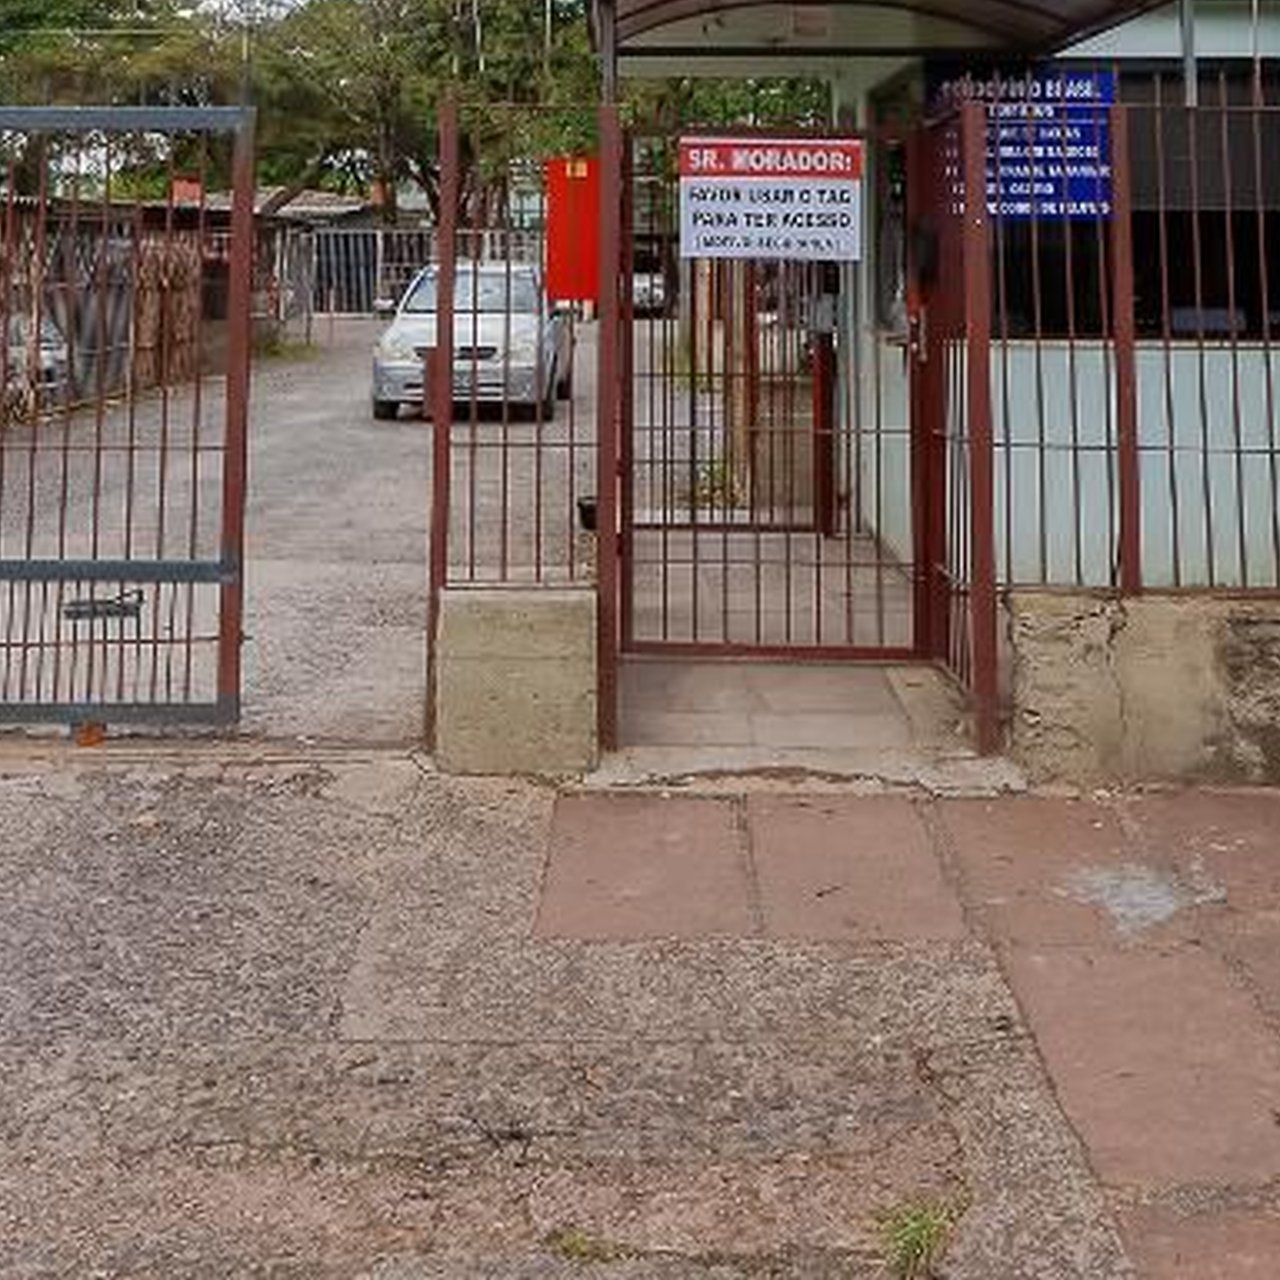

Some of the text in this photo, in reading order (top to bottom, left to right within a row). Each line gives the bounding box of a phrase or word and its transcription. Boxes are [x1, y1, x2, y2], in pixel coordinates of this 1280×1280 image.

[688, 150, 853, 171] SR. MORADOR:
[749, 189, 794, 204] USAR
[799, 189, 811, 204] O
[816, 189, 852, 204] TAG
[692, 211, 852, 228] PARA TER ACESSO
